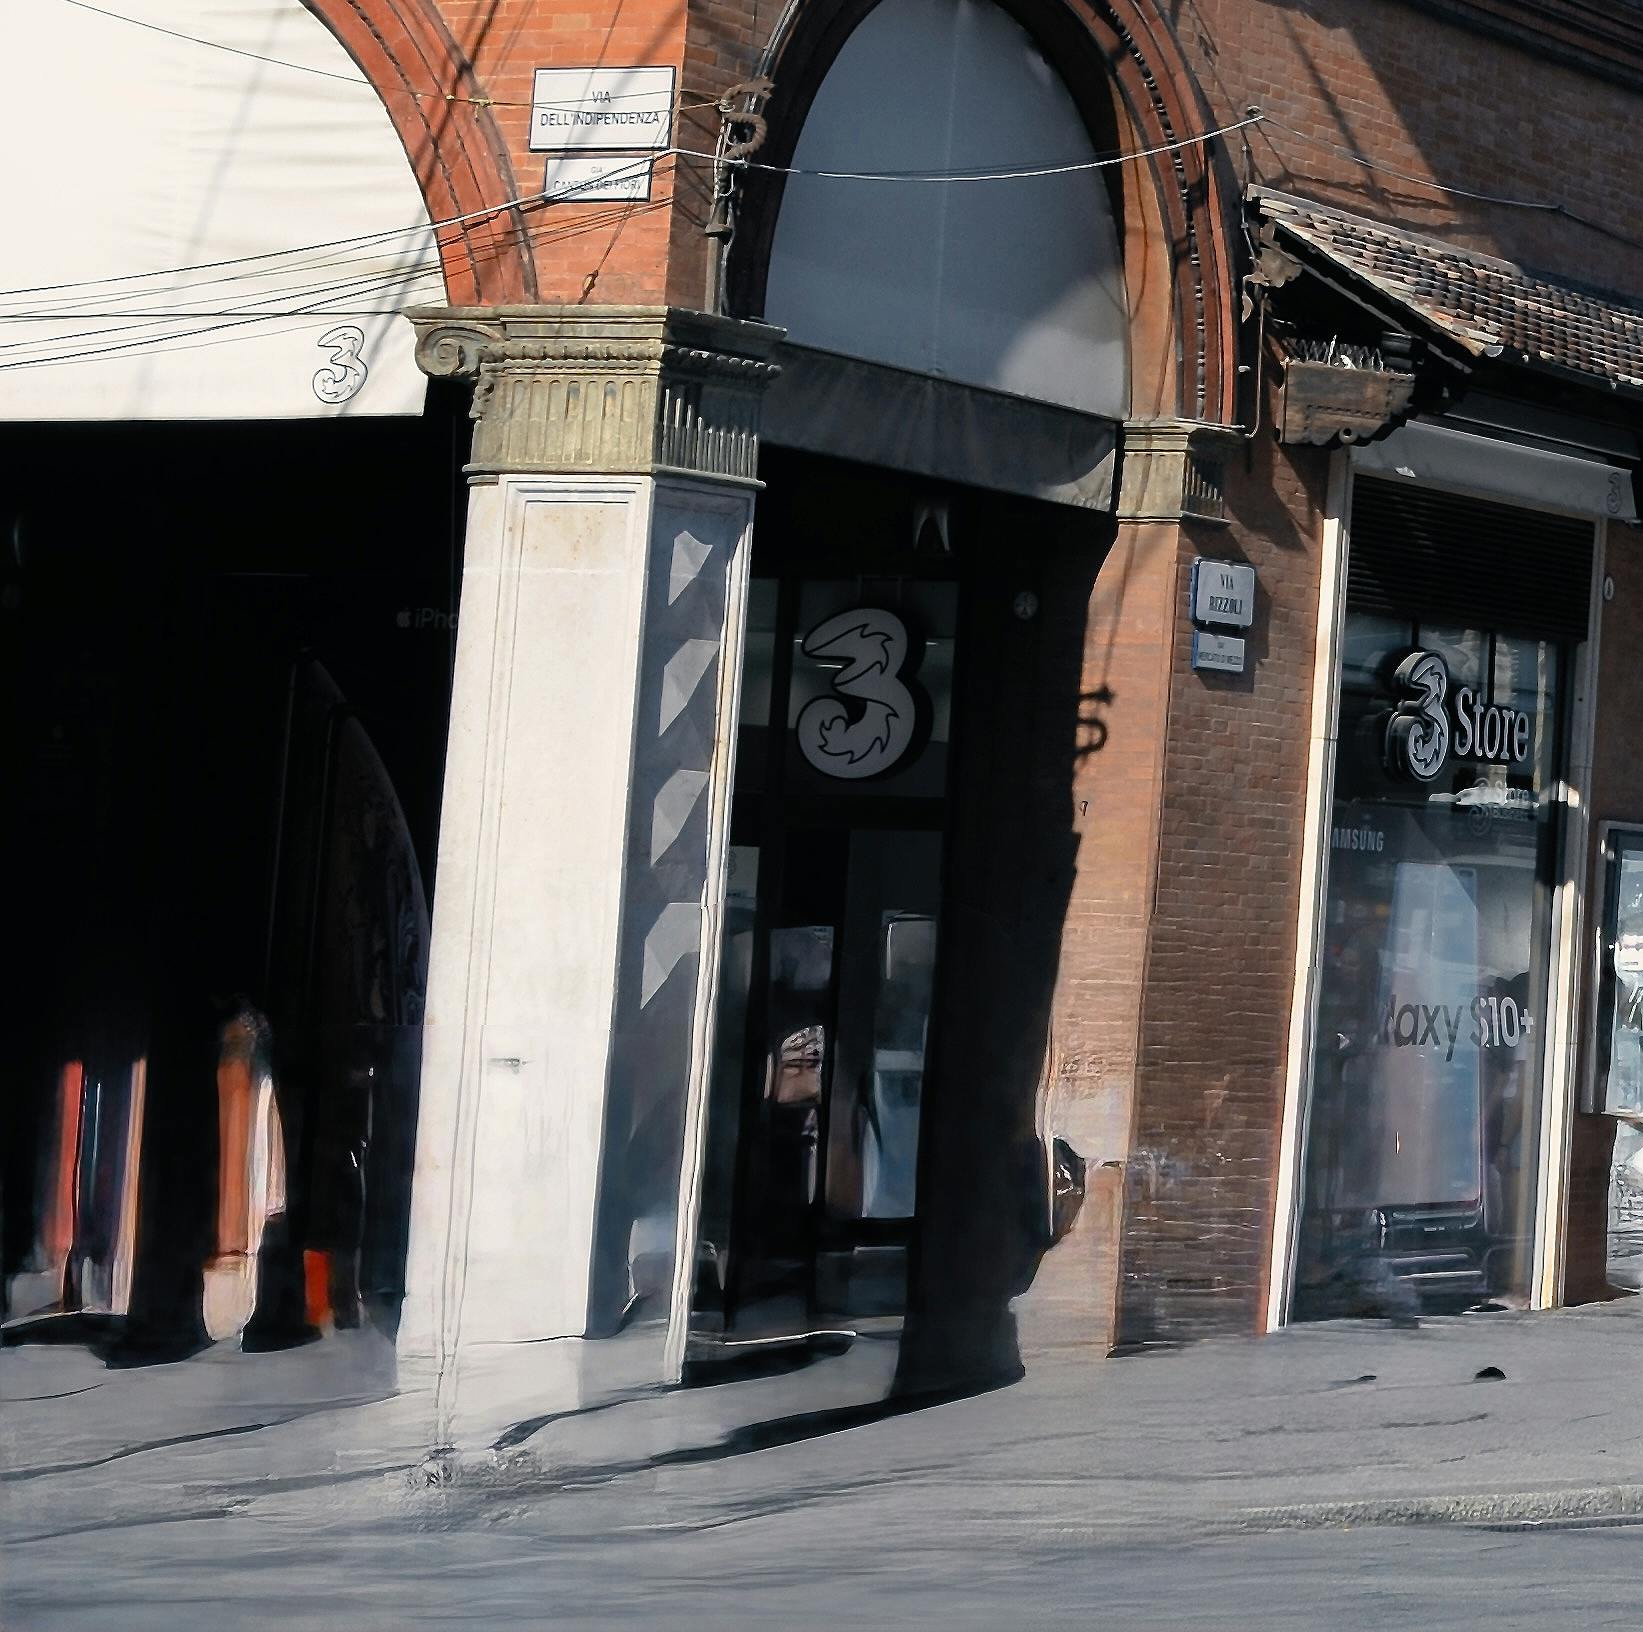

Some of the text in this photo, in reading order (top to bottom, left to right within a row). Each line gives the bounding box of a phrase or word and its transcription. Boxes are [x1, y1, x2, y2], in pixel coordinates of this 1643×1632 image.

[592, 91, 612, 103] VIA
[540, 112, 660, 126] DELL'INDIPENDENZA
[312, 326, 368, 404] 3
[1220, 574, 1234, 590] VIA
[1209, 596, 1243, 615] RIZZOLI
[796, 606, 916, 780] 3
[1393, 651, 1529, 780] 3 Store
[1332, 827, 1385, 852] AMSUNG
[1470, 996, 1534, 1048] S10+
